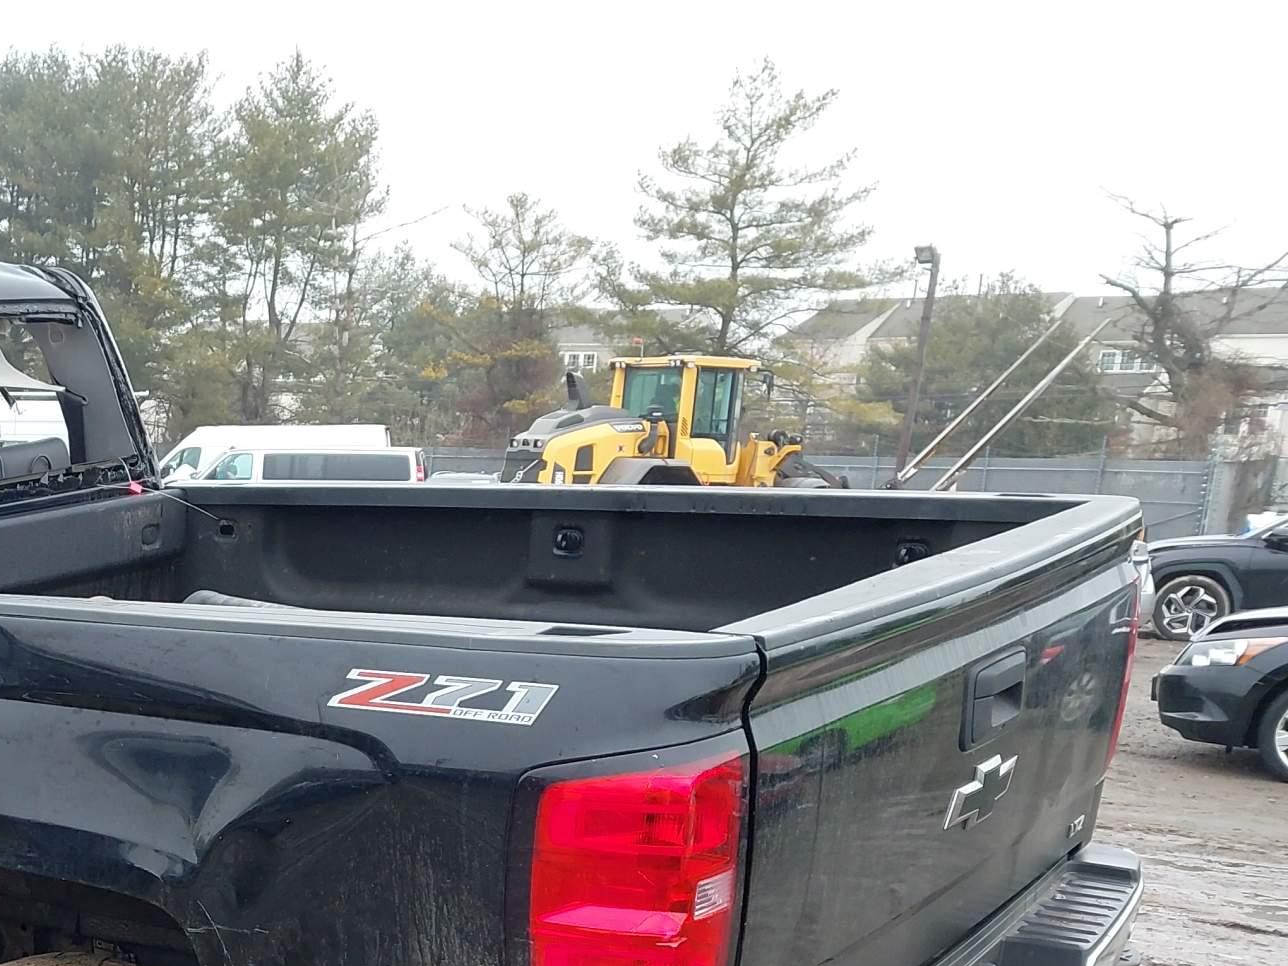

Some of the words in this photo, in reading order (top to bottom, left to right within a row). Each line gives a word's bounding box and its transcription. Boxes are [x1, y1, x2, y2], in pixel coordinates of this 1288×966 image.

[327, 668, 560, 716] Z71
[453, 709, 484, 718] OFF
[487, 712, 534, 723] ROAD
